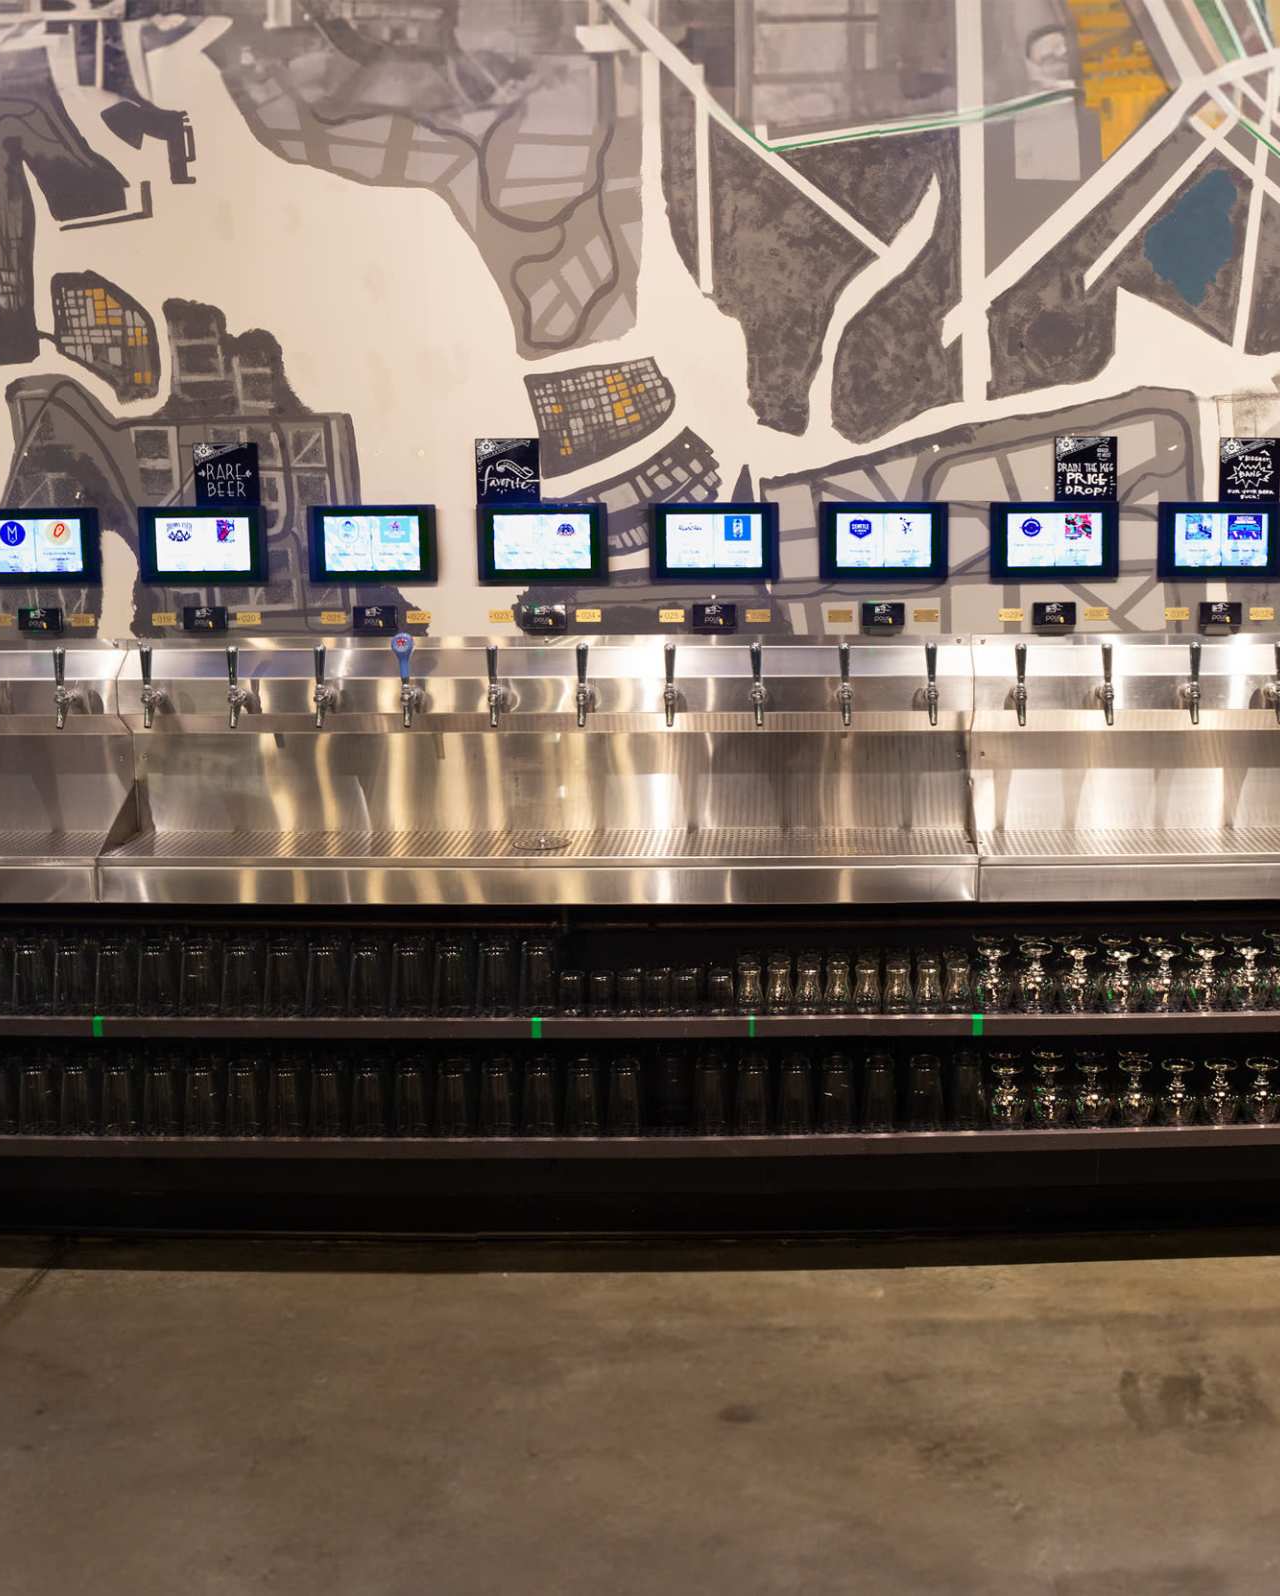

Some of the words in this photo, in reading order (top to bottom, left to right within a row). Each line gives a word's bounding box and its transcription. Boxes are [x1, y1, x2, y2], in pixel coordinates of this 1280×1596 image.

[206, 463, 242, 480] RARE
[1057, 462, 1082, 473] DRAIN
[1083, 462, 1098, 473] THE
[1099, 463, 1114, 473] KEG
[1238, 470, 1262, 478] BANG
[480, 465, 540, 496] favorite
[1066, 473, 1108, 486] PRICE
[207, 481, 246, 497] BEER
[1065, 485, 1108, 497] DROP!
